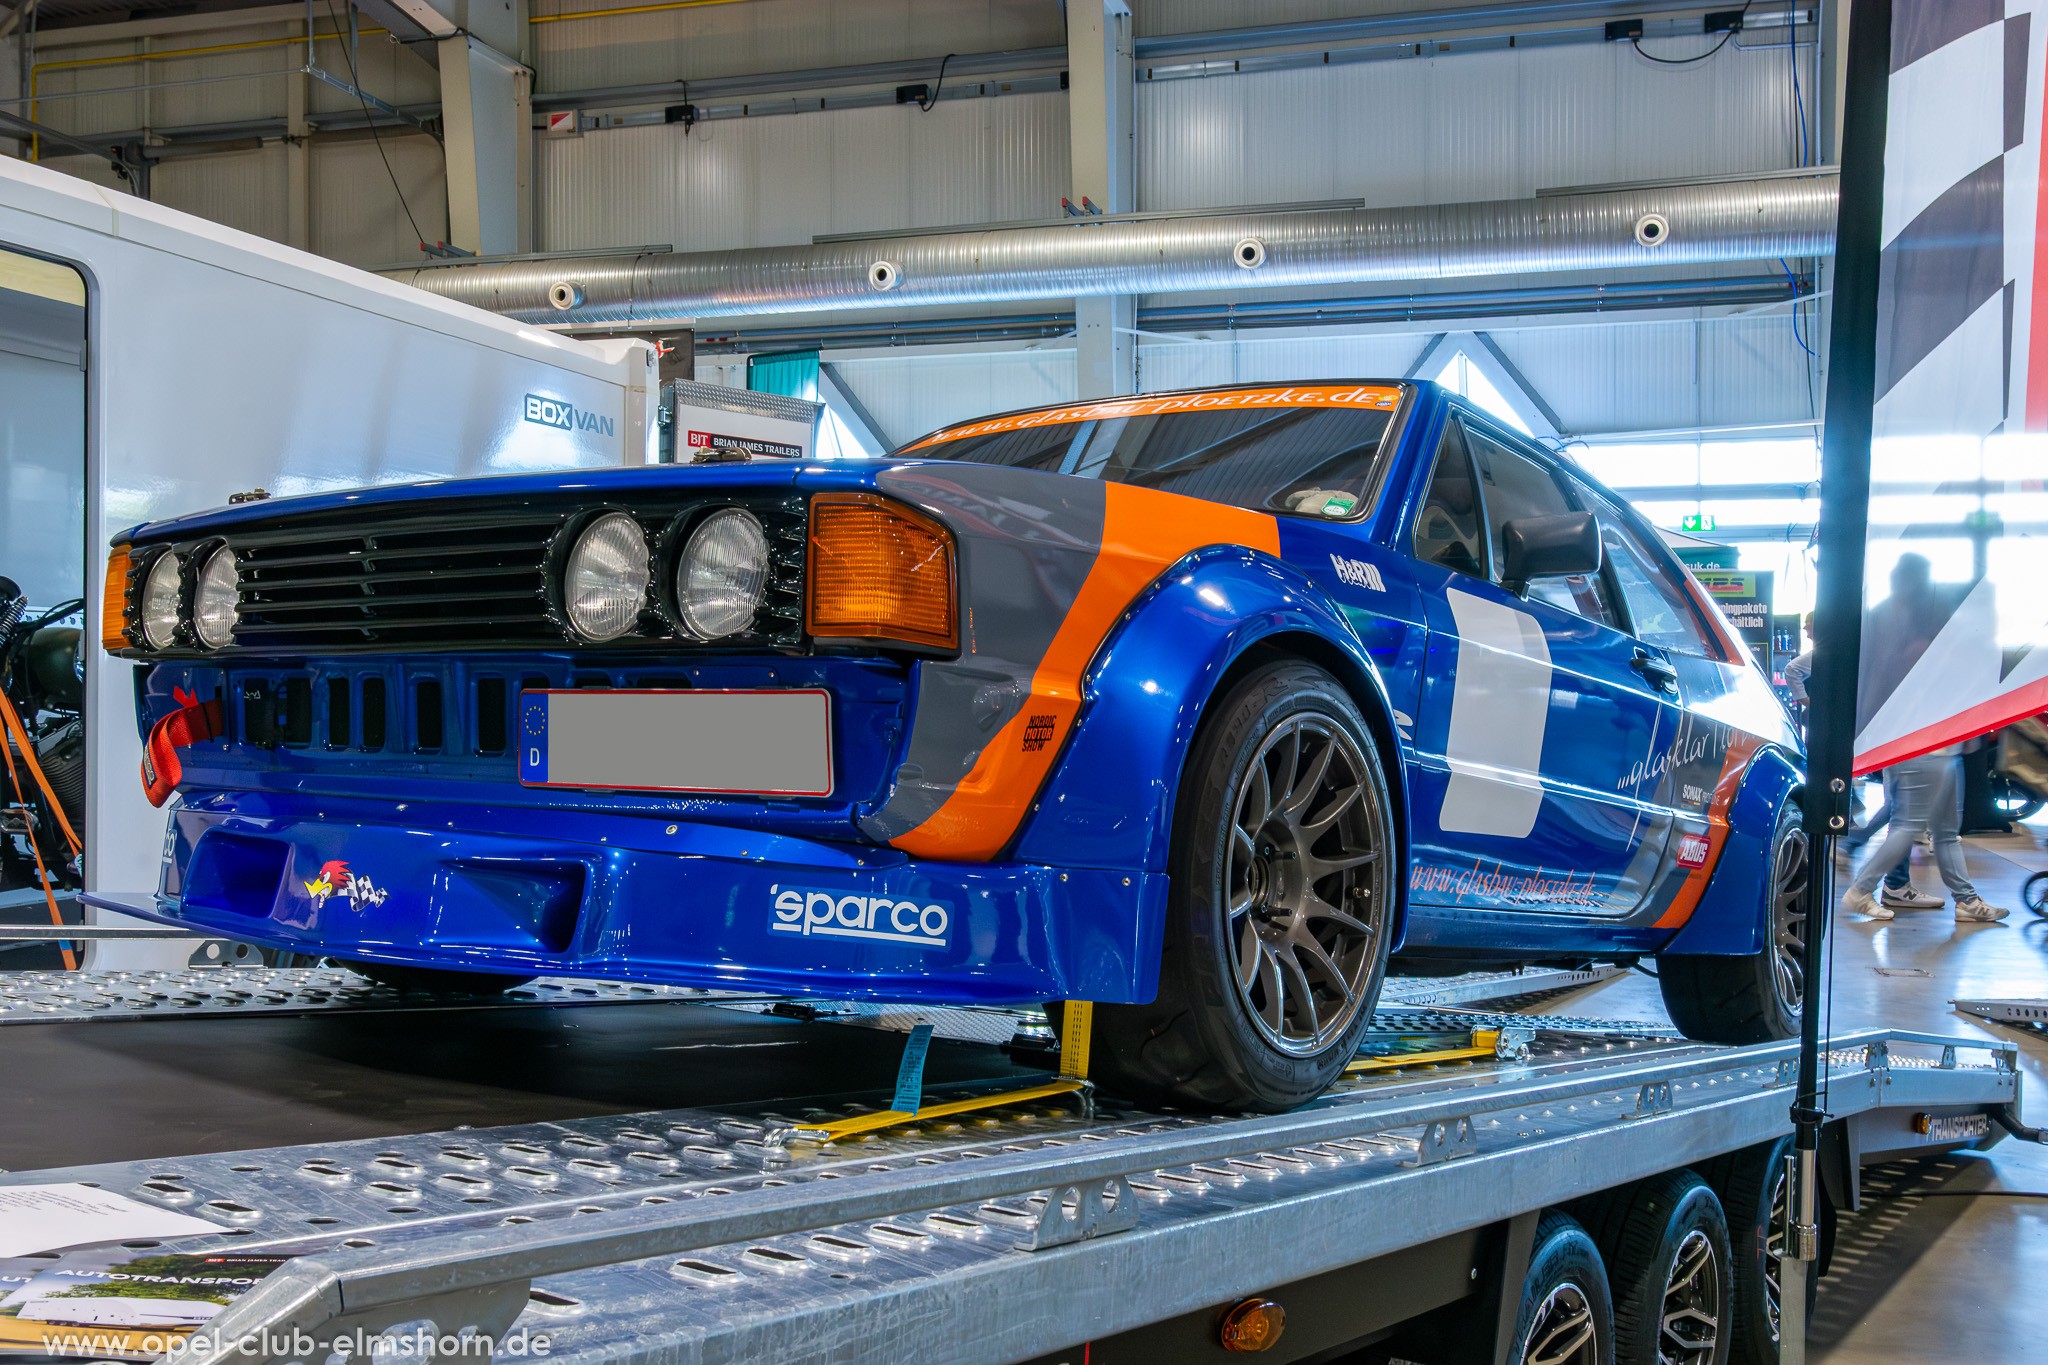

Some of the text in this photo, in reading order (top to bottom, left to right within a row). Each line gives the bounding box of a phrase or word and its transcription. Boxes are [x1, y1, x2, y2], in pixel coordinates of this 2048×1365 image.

[690, 431, 709, 447] BJT
[713, 436, 738, 450] BRIAN
[764, 443, 800, 458] TRAILERS
[1030, 714, 1057, 727] NORDIC
[1025, 727, 1053, 740] MOTOR
[1022, 739, 1045, 752] SHOW
[529, 747, 540, 766] D
[770, 883, 949, 936] sparco
